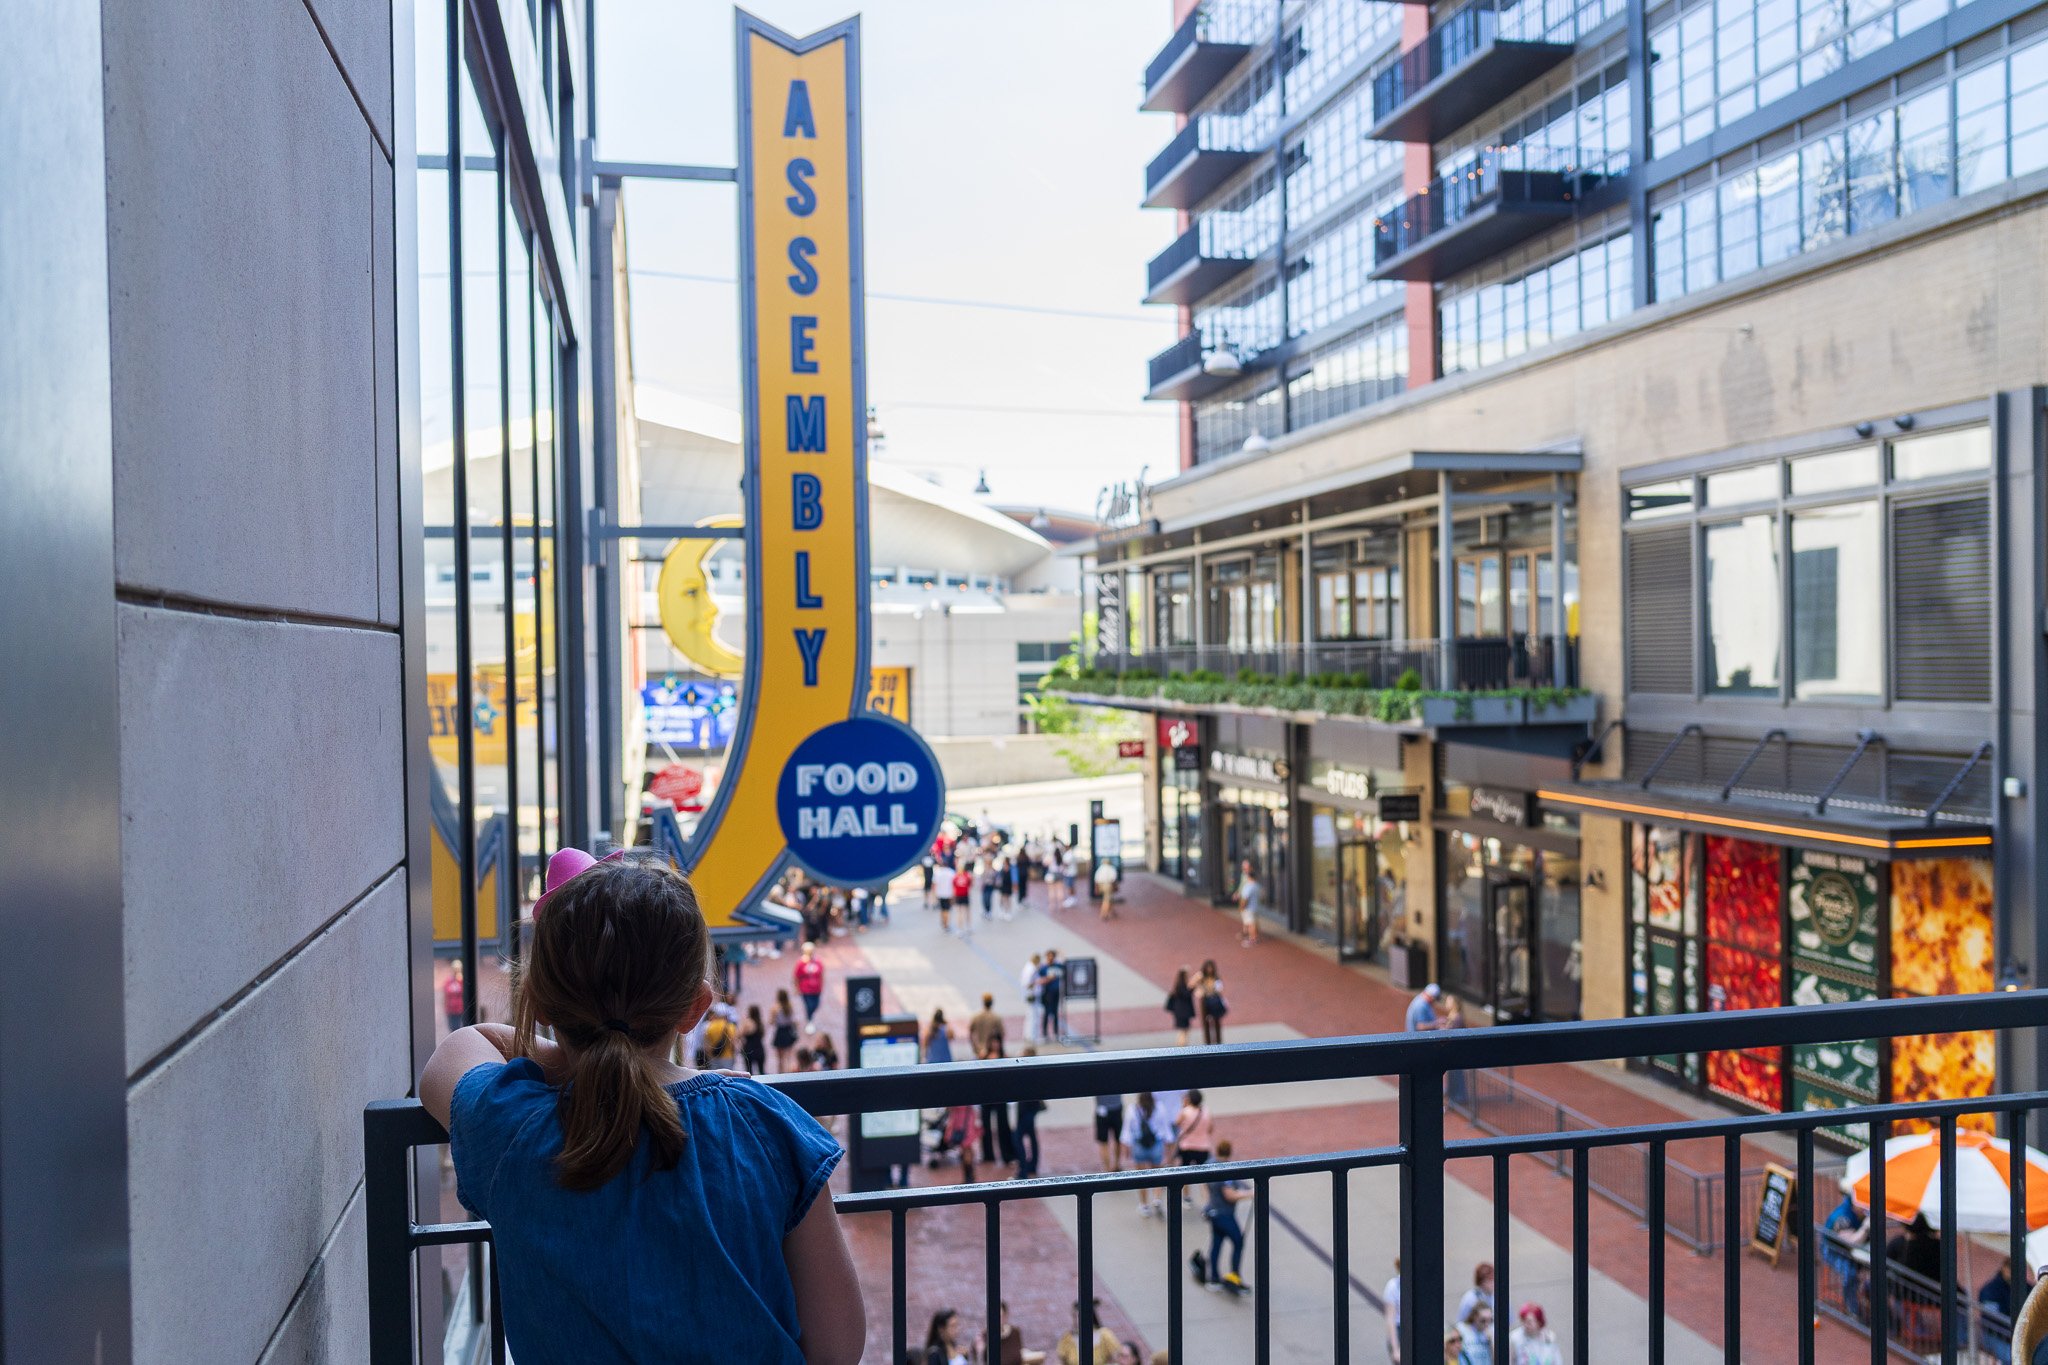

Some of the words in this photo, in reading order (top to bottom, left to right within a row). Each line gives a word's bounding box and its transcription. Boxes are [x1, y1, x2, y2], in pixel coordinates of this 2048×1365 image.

[783, 79, 827, 687] ASSEMBLY
[796, 761, 919, 797] FOOD
[798, 804, 918, 839] HALL
